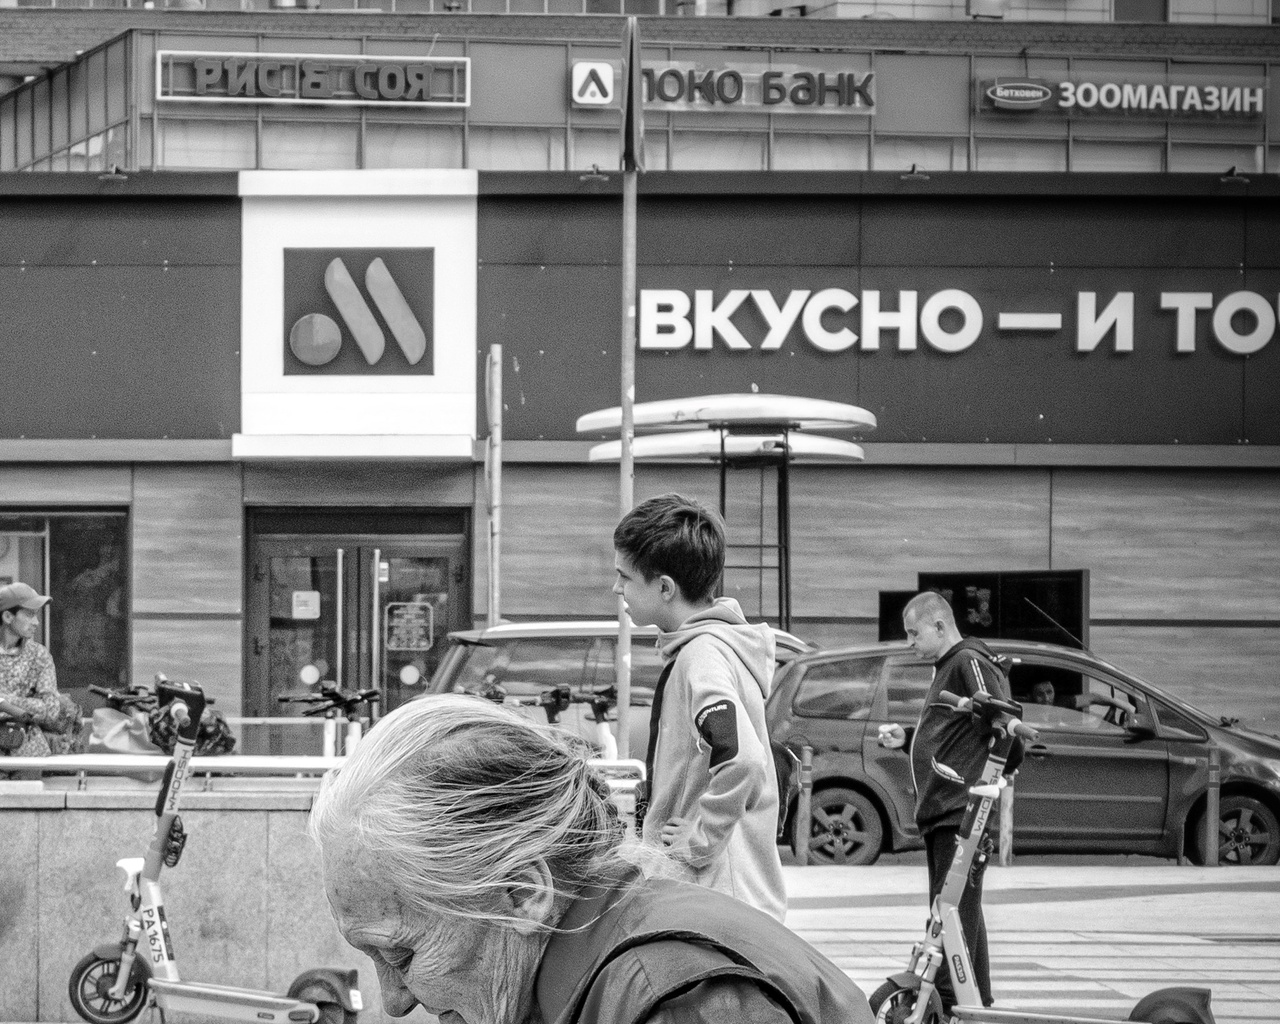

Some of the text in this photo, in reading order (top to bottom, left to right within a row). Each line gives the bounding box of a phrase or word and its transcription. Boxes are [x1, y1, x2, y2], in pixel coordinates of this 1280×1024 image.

[194, 57, 281, 97] РИС
[354, 63, 434, 100] СОЯ
[995, 86, 1043, 98] Бетховен
[1058, 82, 1263, 112] ЗООМАГАЗИН
[639, 288, 983, 352] ВКУСНО
[1077, 291, 1134, 352] И
[1160, 290, 1280, 353] ТО
[168, 749, 189, 812] WHOOSH
[974, 767, 1001, 832] WHOSH
